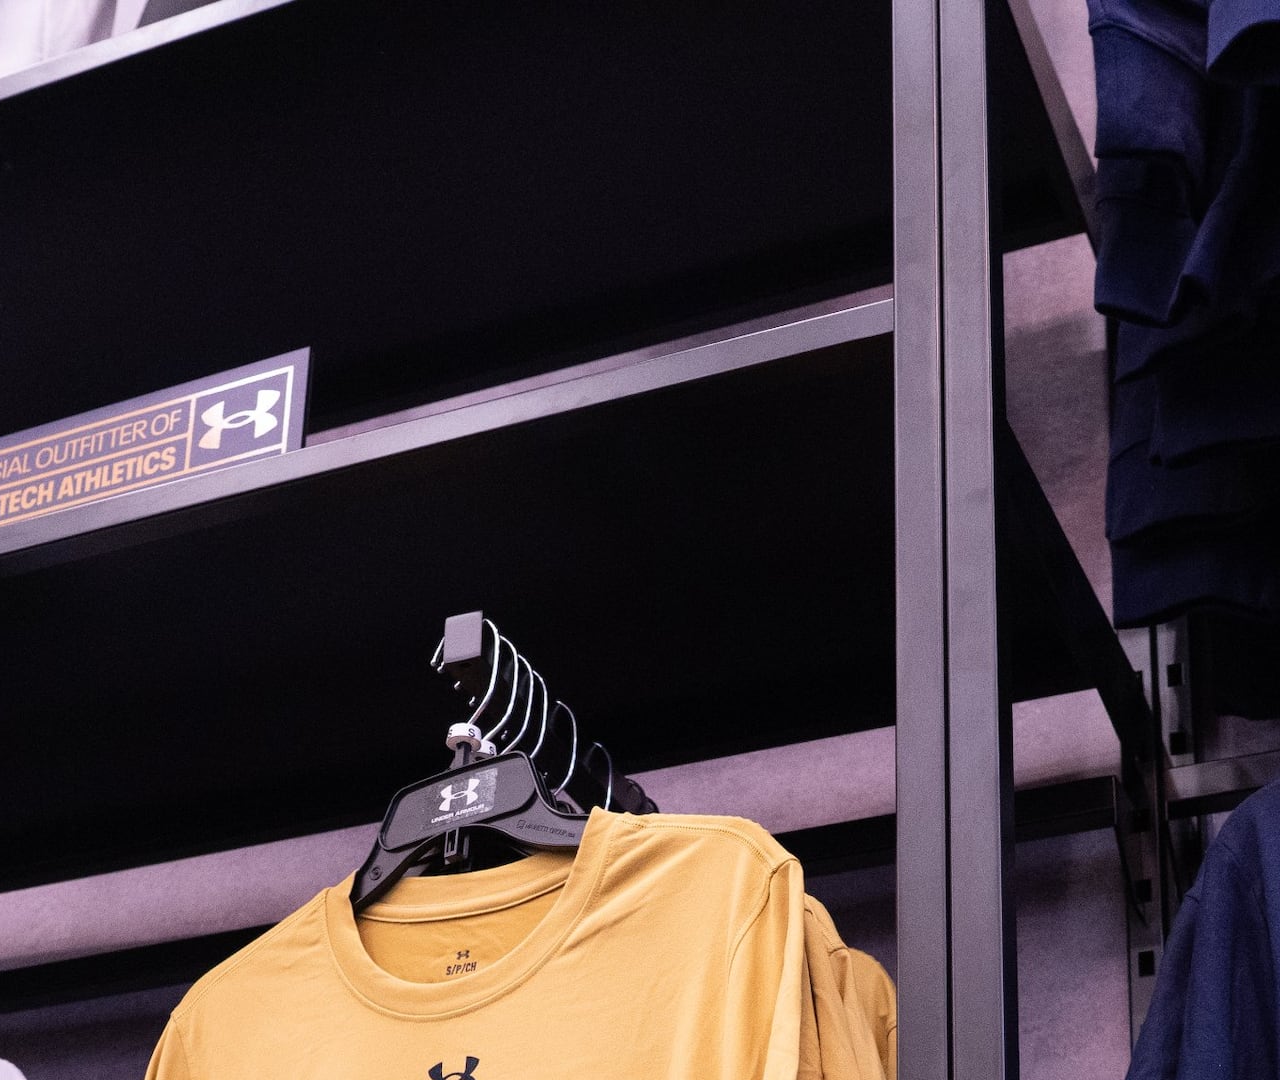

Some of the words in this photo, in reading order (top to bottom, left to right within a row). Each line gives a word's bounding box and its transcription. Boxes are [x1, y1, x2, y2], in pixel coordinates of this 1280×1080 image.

[35, 419, 148, 469] OUTFITTER
[150, 408, 182, 436] OF
[57, 446, 177, 500] ATHLETICS
[468, 728, 476, 738] S
[446, 961, 477, 976] S/P/CH
